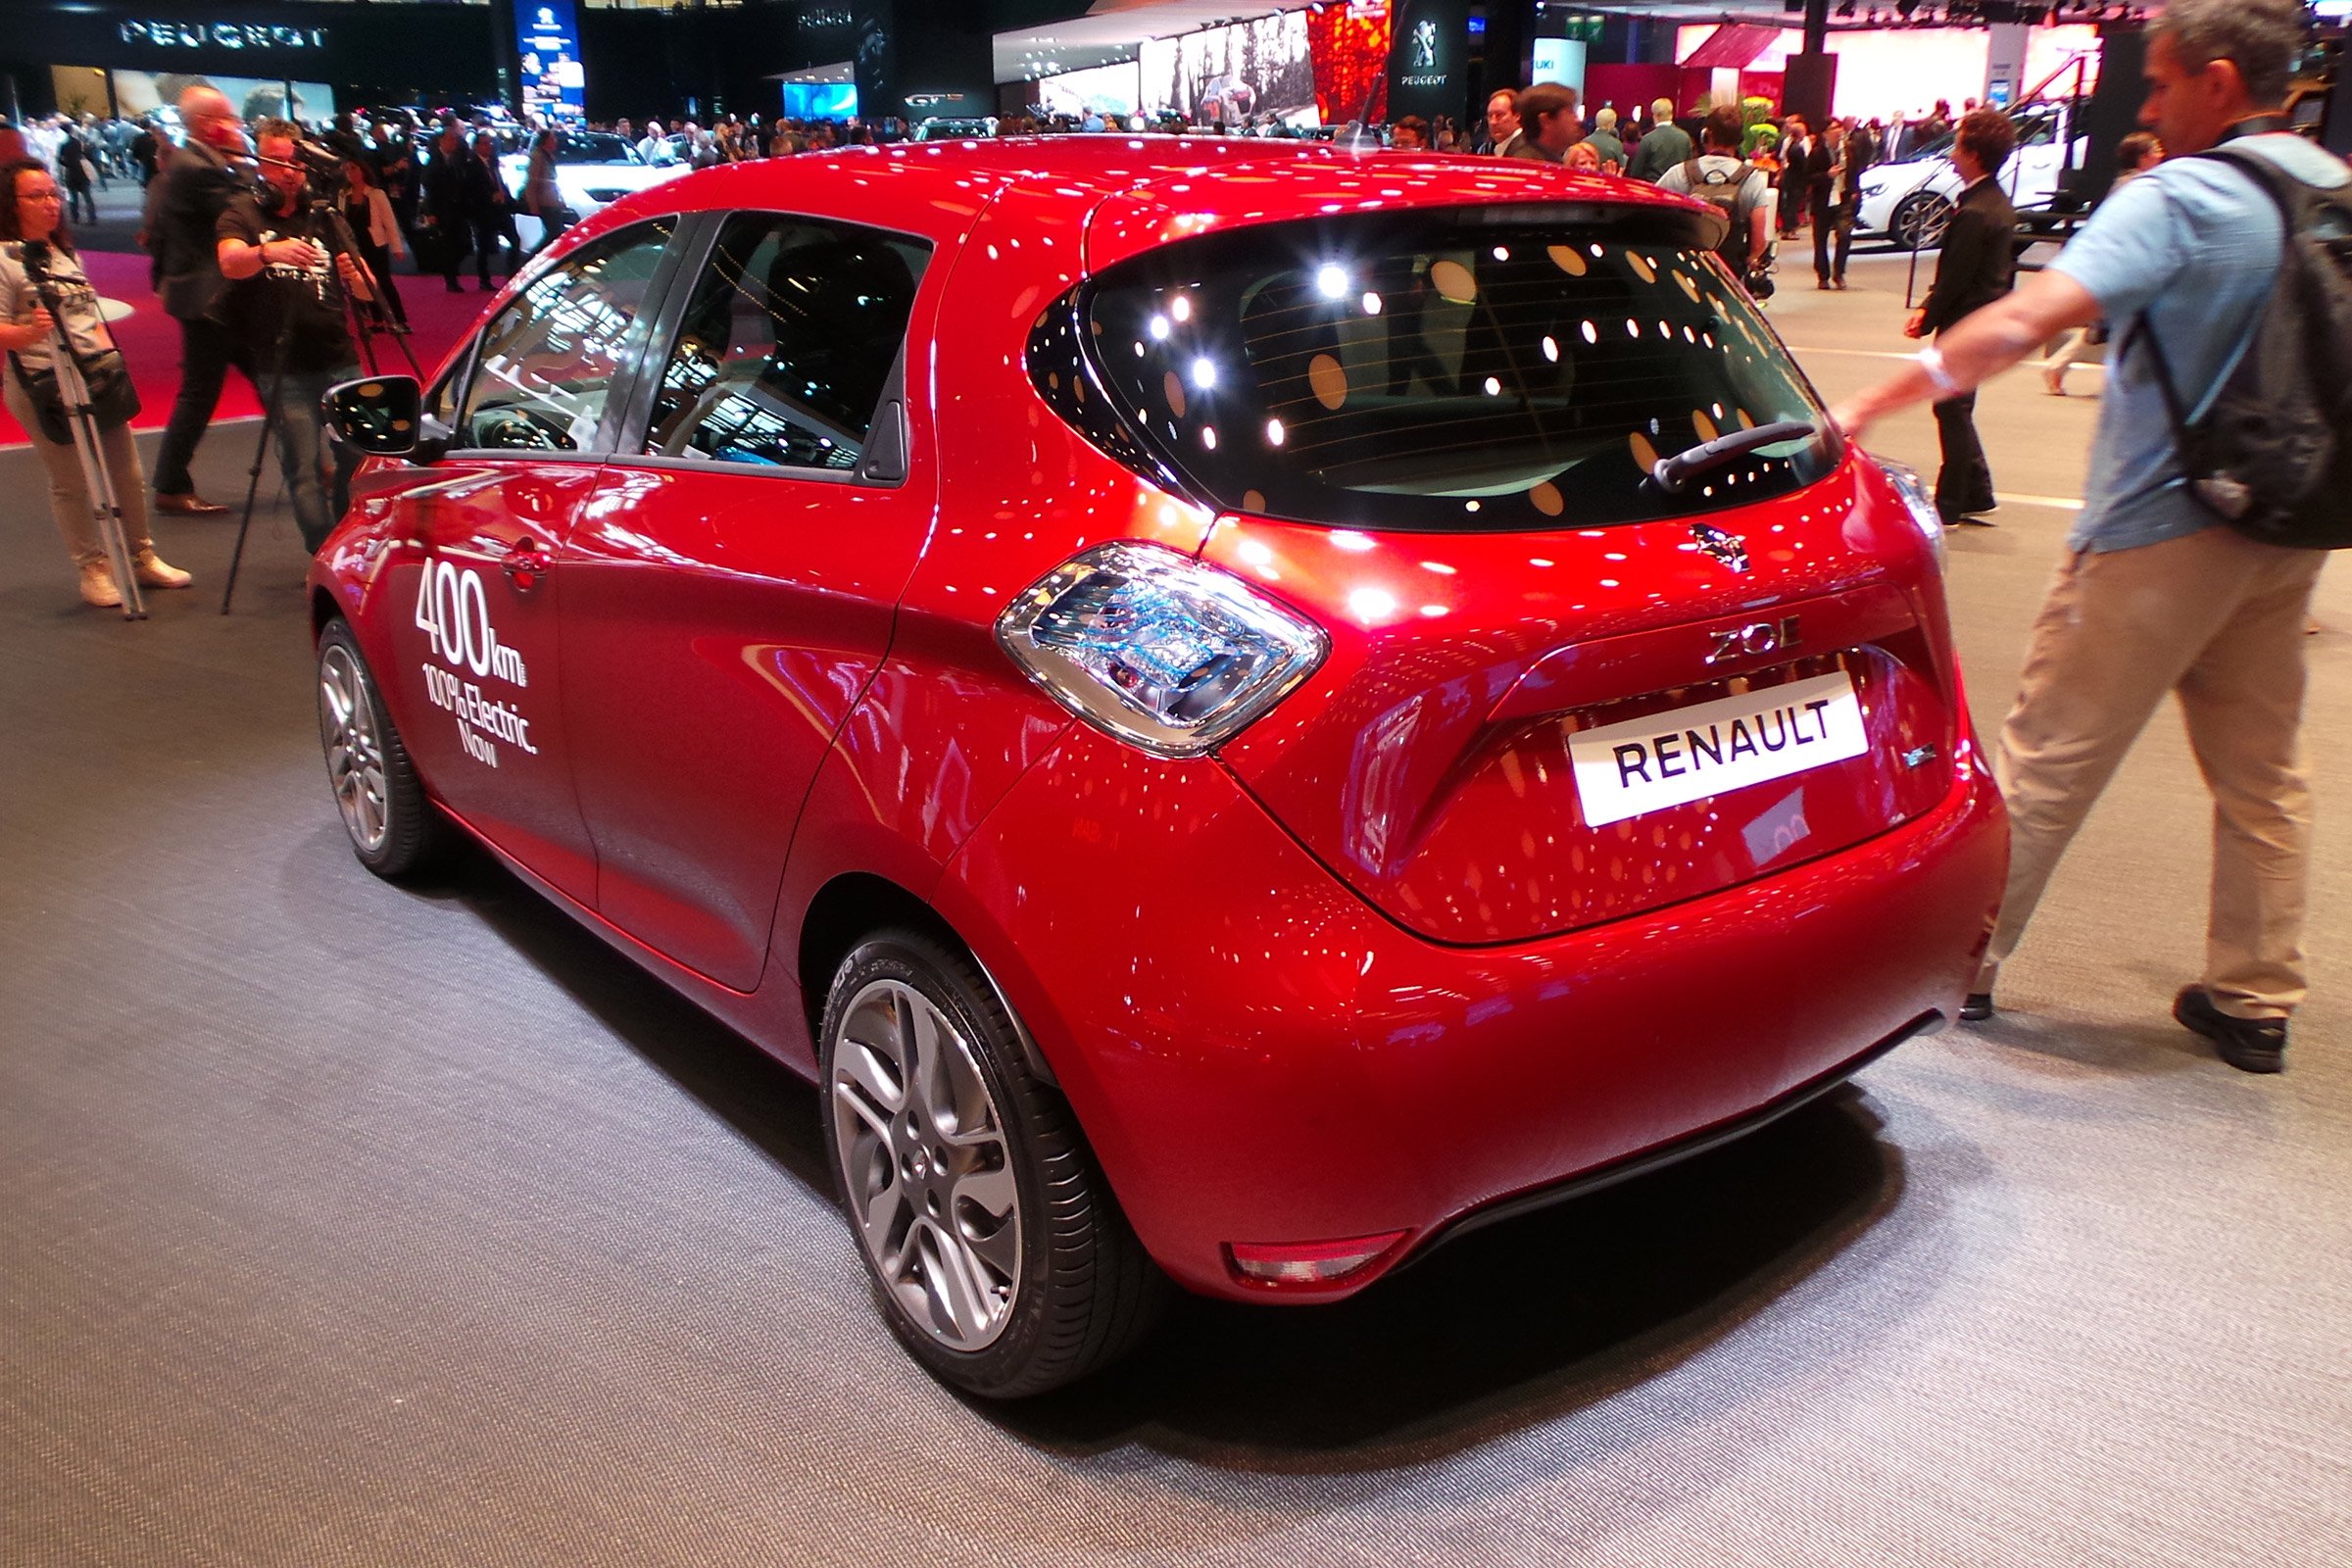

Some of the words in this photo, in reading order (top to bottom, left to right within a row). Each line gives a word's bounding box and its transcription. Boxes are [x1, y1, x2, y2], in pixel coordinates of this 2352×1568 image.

[1401, 74, 1448, 86] PEUGEOT
[1705, 613, 1804, 664] ZOE
[422, 662, 469, 720] 100%
[458, 717, 499, 769] Now
[1612, 699, 1830, 789] RENAULT
